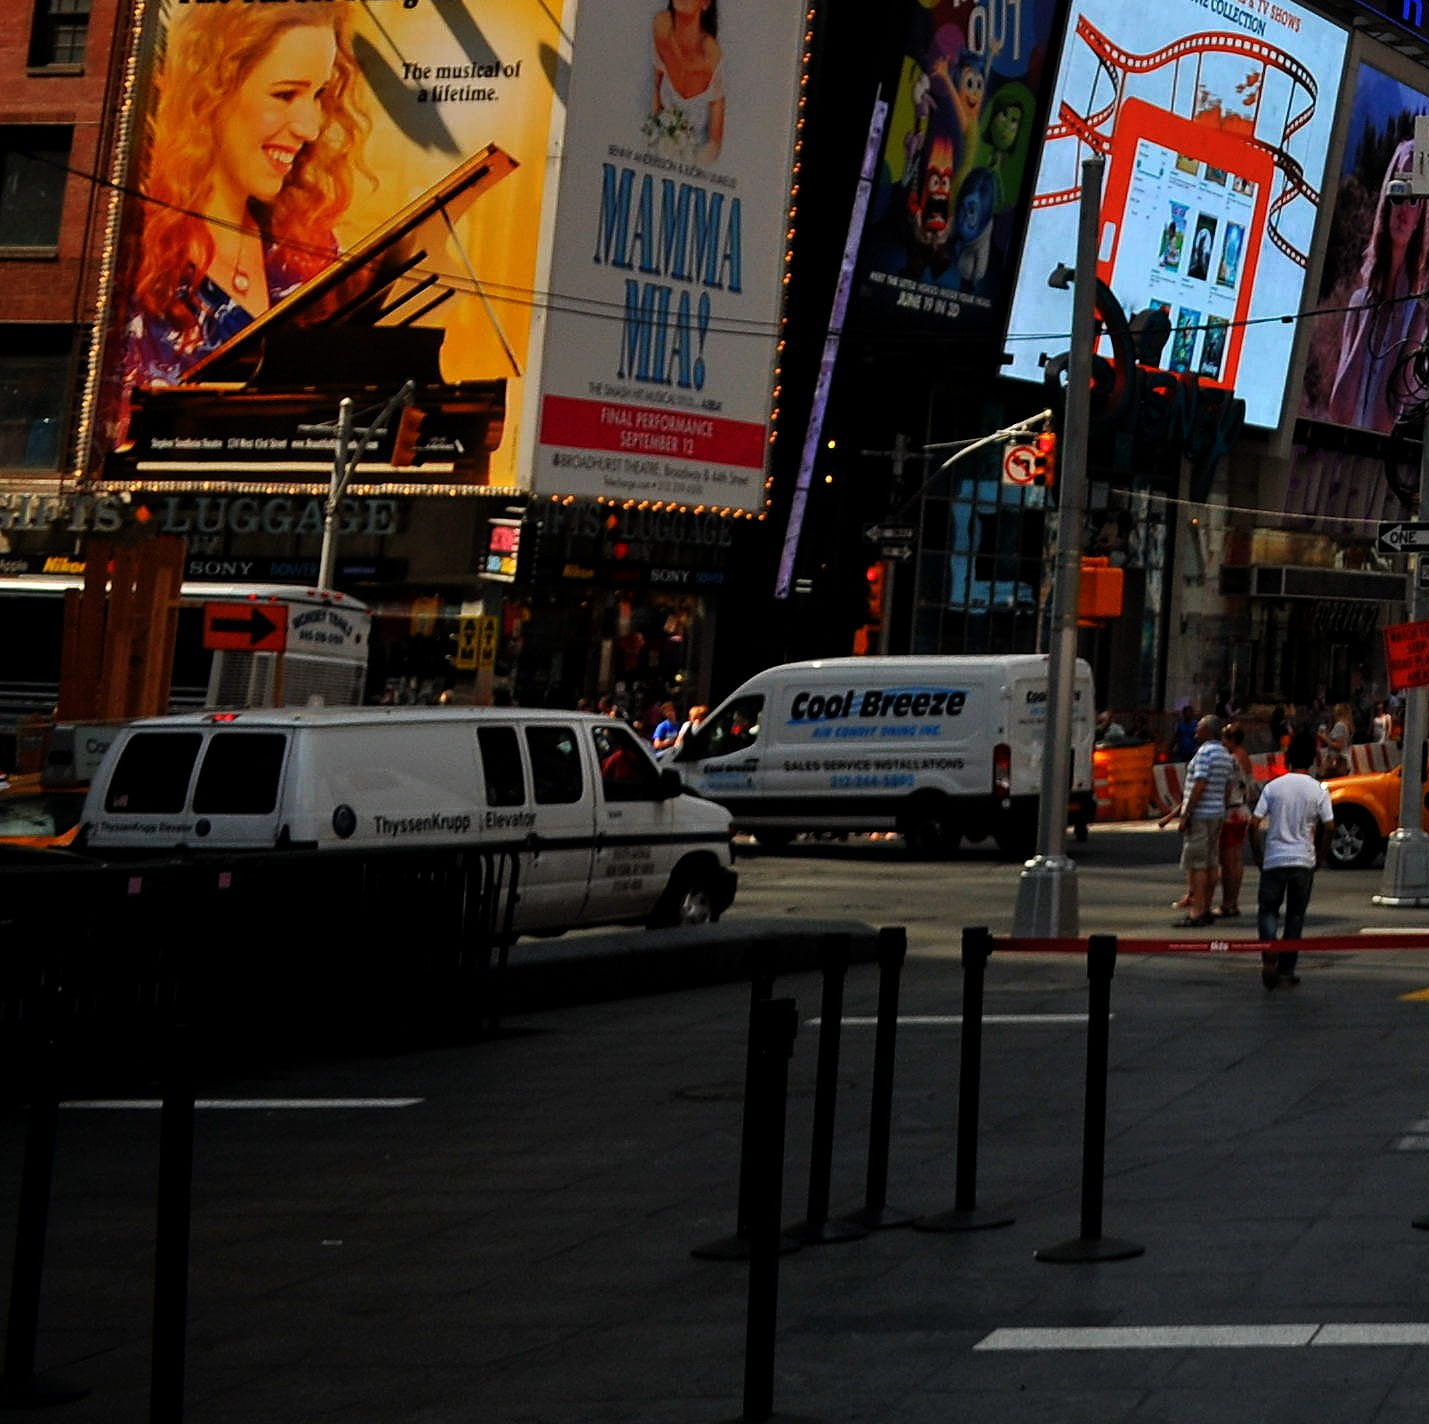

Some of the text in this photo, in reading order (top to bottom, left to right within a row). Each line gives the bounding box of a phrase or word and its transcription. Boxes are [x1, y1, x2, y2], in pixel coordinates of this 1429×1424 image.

[1271, 2, 1303, 32] SHOWS
[402, 59, 522, 81] The musical of
[418, 85, 500, 102] a lifetime.
[594, 162, 742, 294] MAMMA
[617, 279, 711, 391] MIA!
[600, 407, 714, 439] FINAL PERFORMANCE
[619, 429, 681, 454] SEPTEMBER
[161, 498, 397, 535] LUGGAGE
[1391, 532, 1416, 543] ONE
[190, 561, 254, 576] SONY
[461, 619, 475, 661] ATM
[482, 620, 495, 660] ATM
[792, 689, 965, 720] Cool Breeze
[784, 757, 964, 772] SALES SERVICE INSTALLATIONS
[374, 812, 536, 836] ThyssenKrupp Elevator
